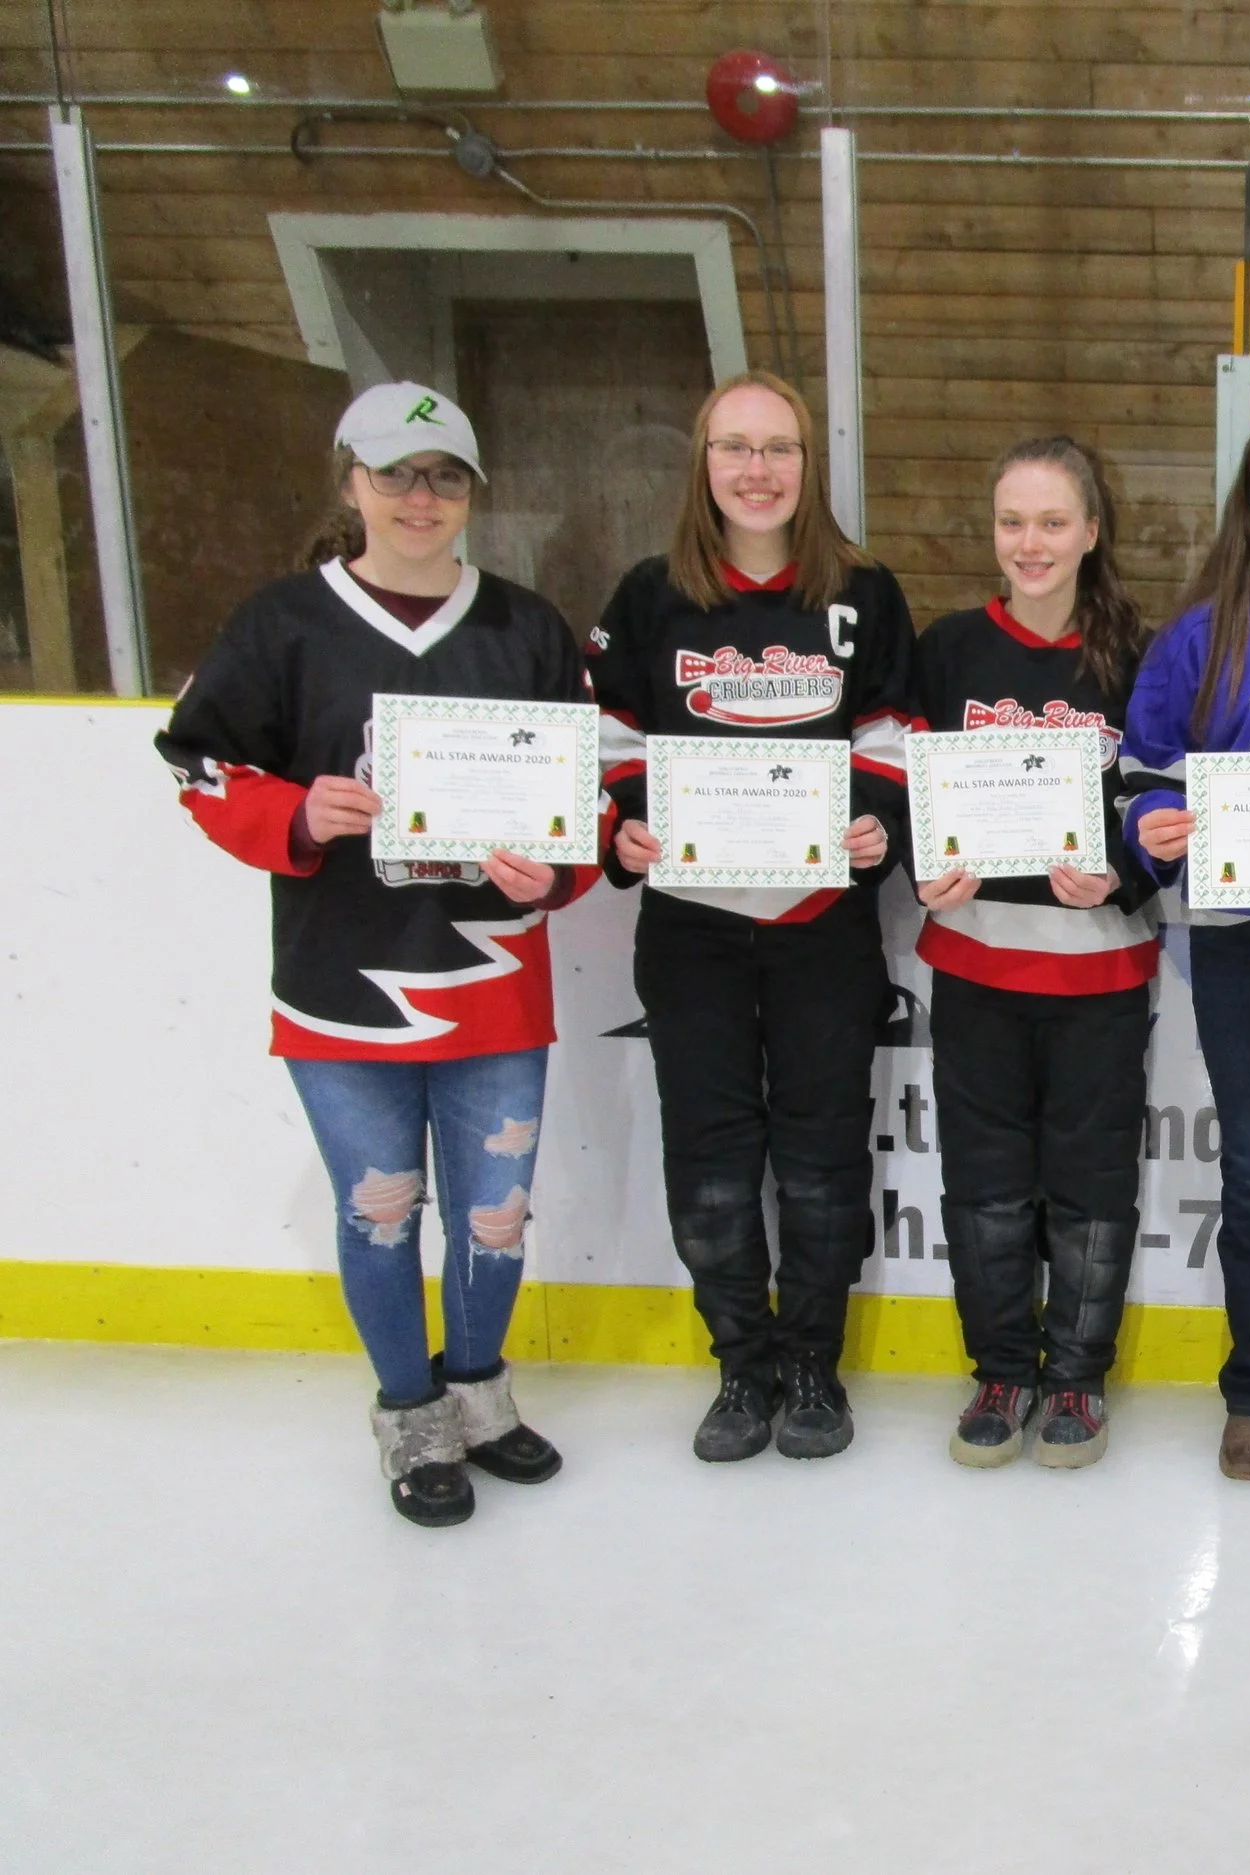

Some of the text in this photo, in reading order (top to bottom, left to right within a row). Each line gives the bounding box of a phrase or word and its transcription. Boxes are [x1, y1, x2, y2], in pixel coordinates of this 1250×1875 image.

[828, 603, 858, 659] C
[713, 645, 830, 684] Big River
[708, 677, 834, 702] CRUSADERS
[994, 698, 1107, 729] Big River
[425, 750, 552, 765] ALL STAR AWARD 2020
[694, 787, 808, 798] ALL STAR AWARD 2020
[952, 777, 1061, 790] ALL STAR AWARD 2020
[1233, 803, 1250, 813] ALL
